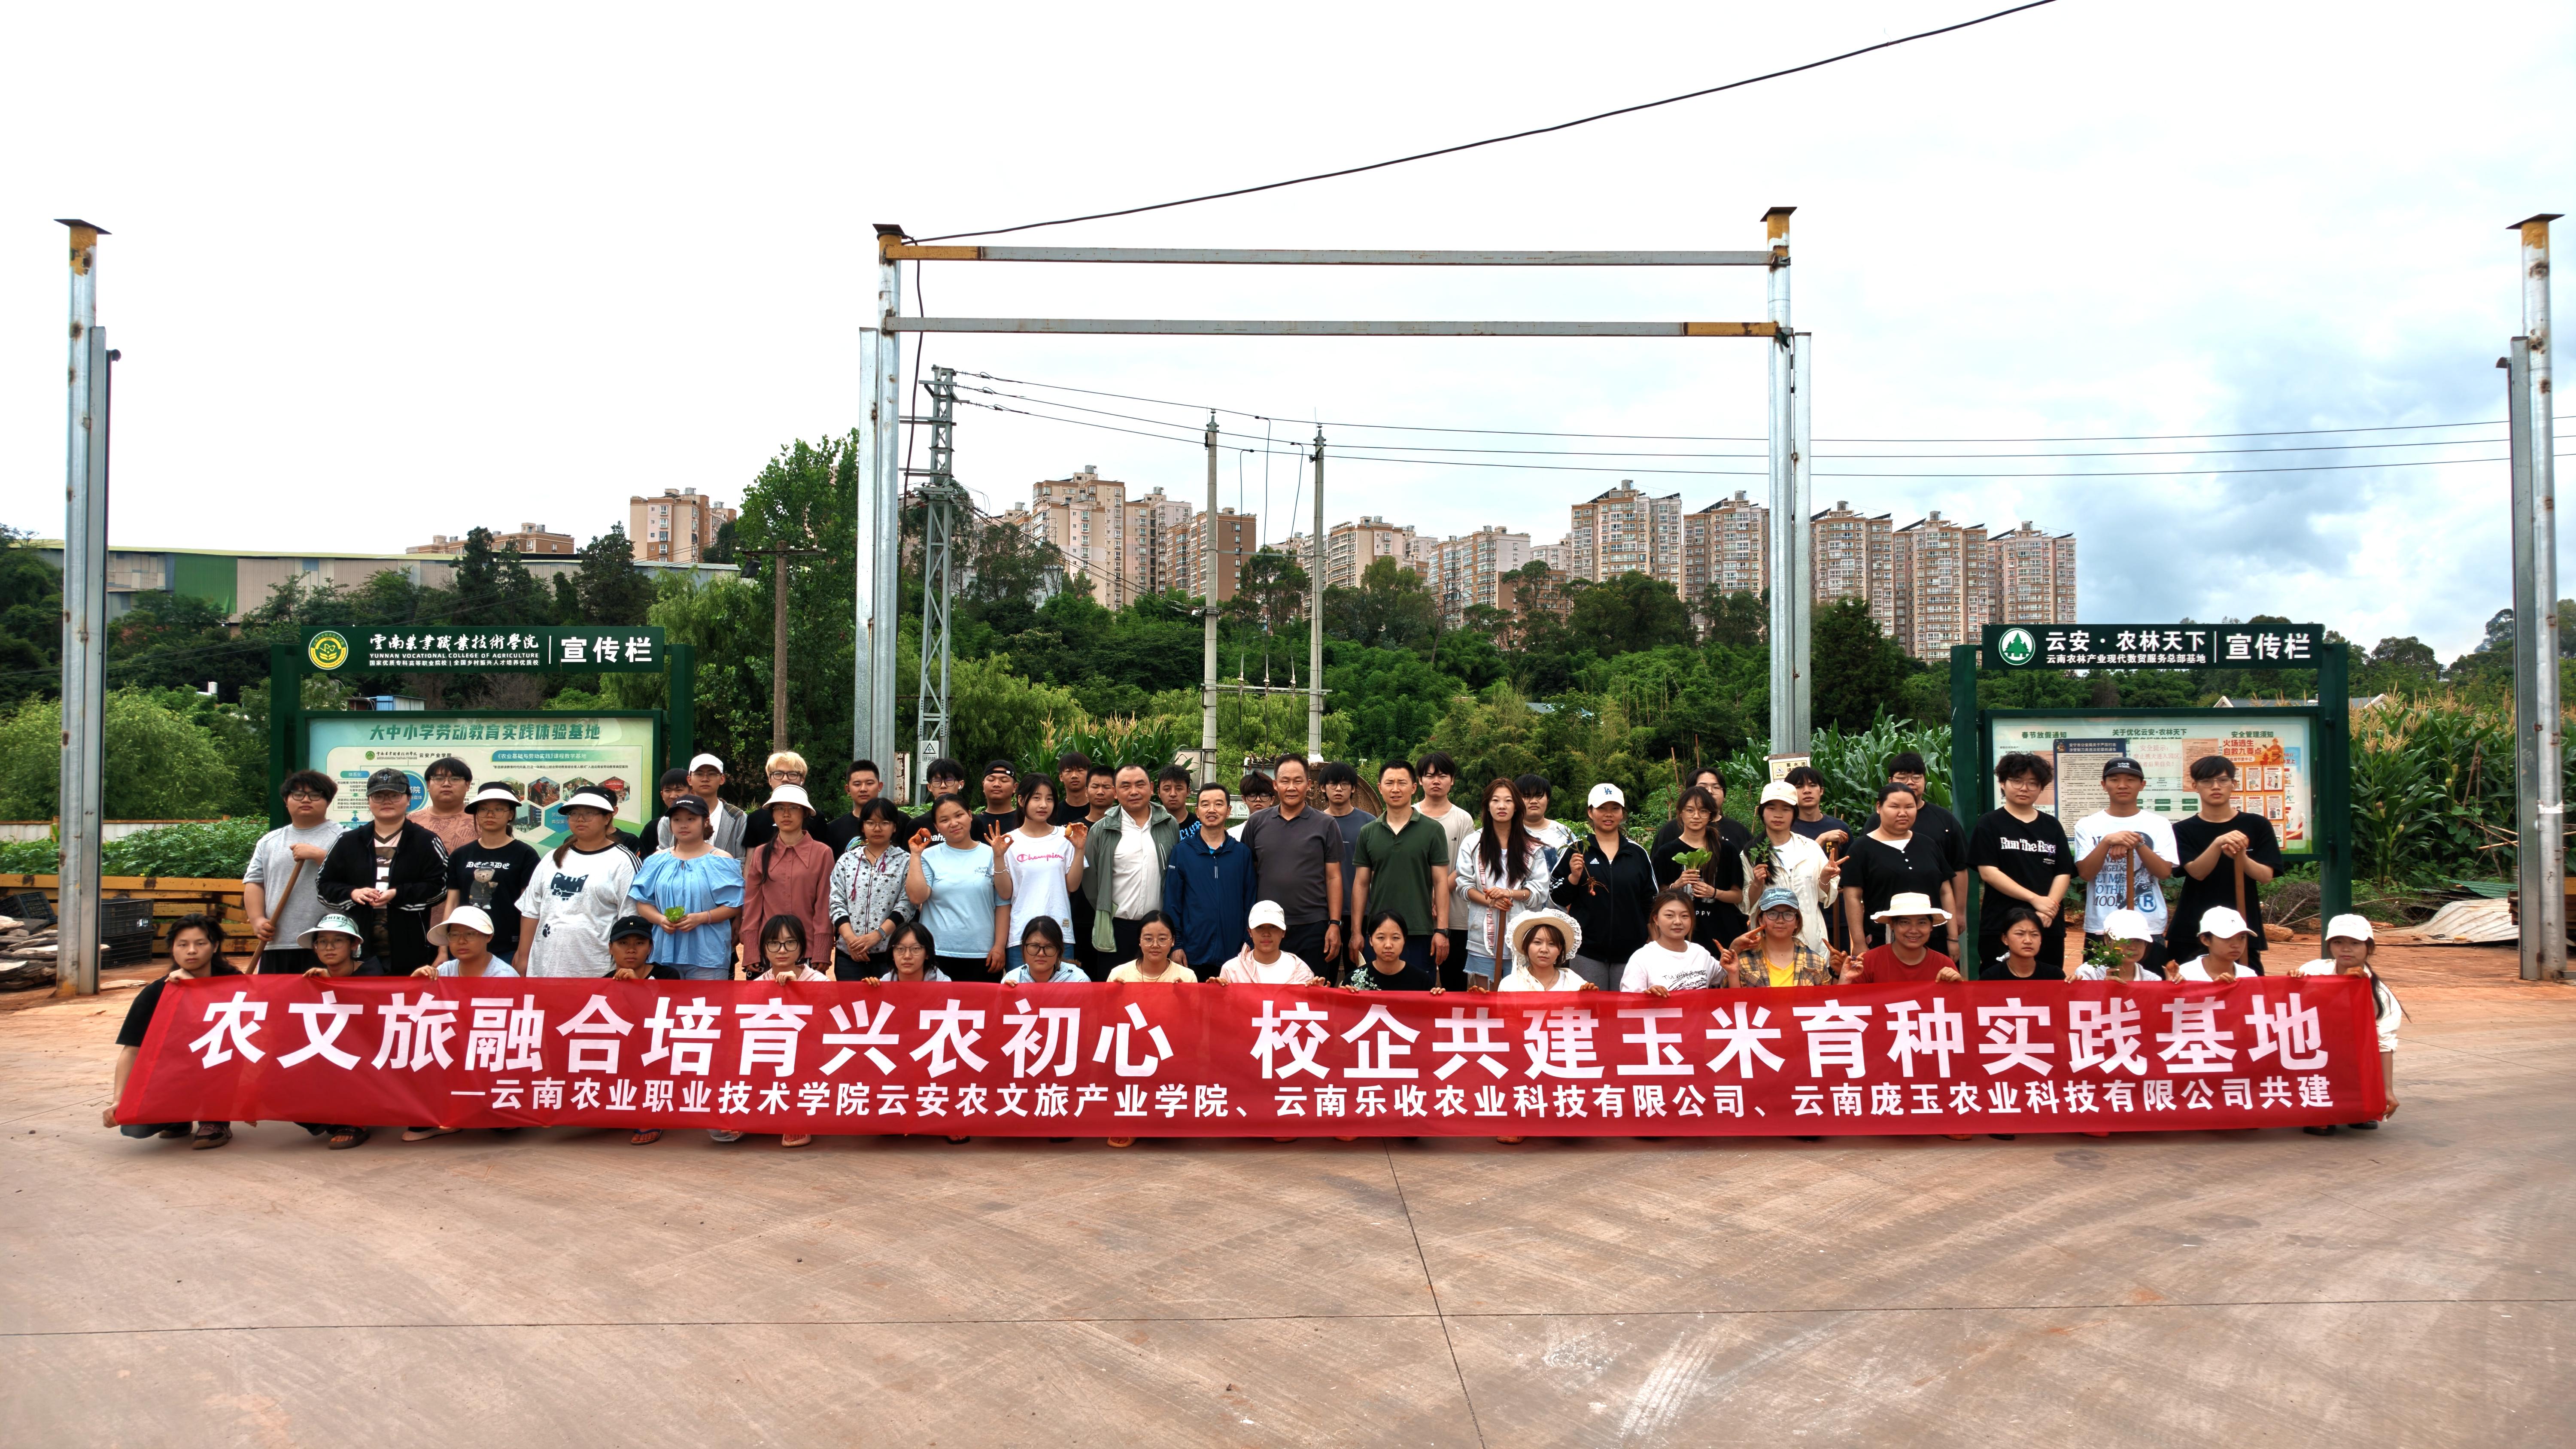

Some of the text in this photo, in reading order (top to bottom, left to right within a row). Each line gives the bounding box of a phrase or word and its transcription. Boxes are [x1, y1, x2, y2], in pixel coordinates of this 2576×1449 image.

[561, 636, 652, 663] 宣传栏
[2226, 633, 2310, 660] 宣传栏
[2046, 654, 2206, 663] 云南农林产业现代数贸服务总部基地
[369, 724, 601, 740] 大中小学劳动教育实践体验基地
[2000, 837, 2020, 850] Run
[2020, 838, 2037, 852] The
[1017, 852, 1064, 862] Champion
[188, 990, 2328, 1081] 农文旅融合培育兴农初心 校企共建玉米育种实践基地
